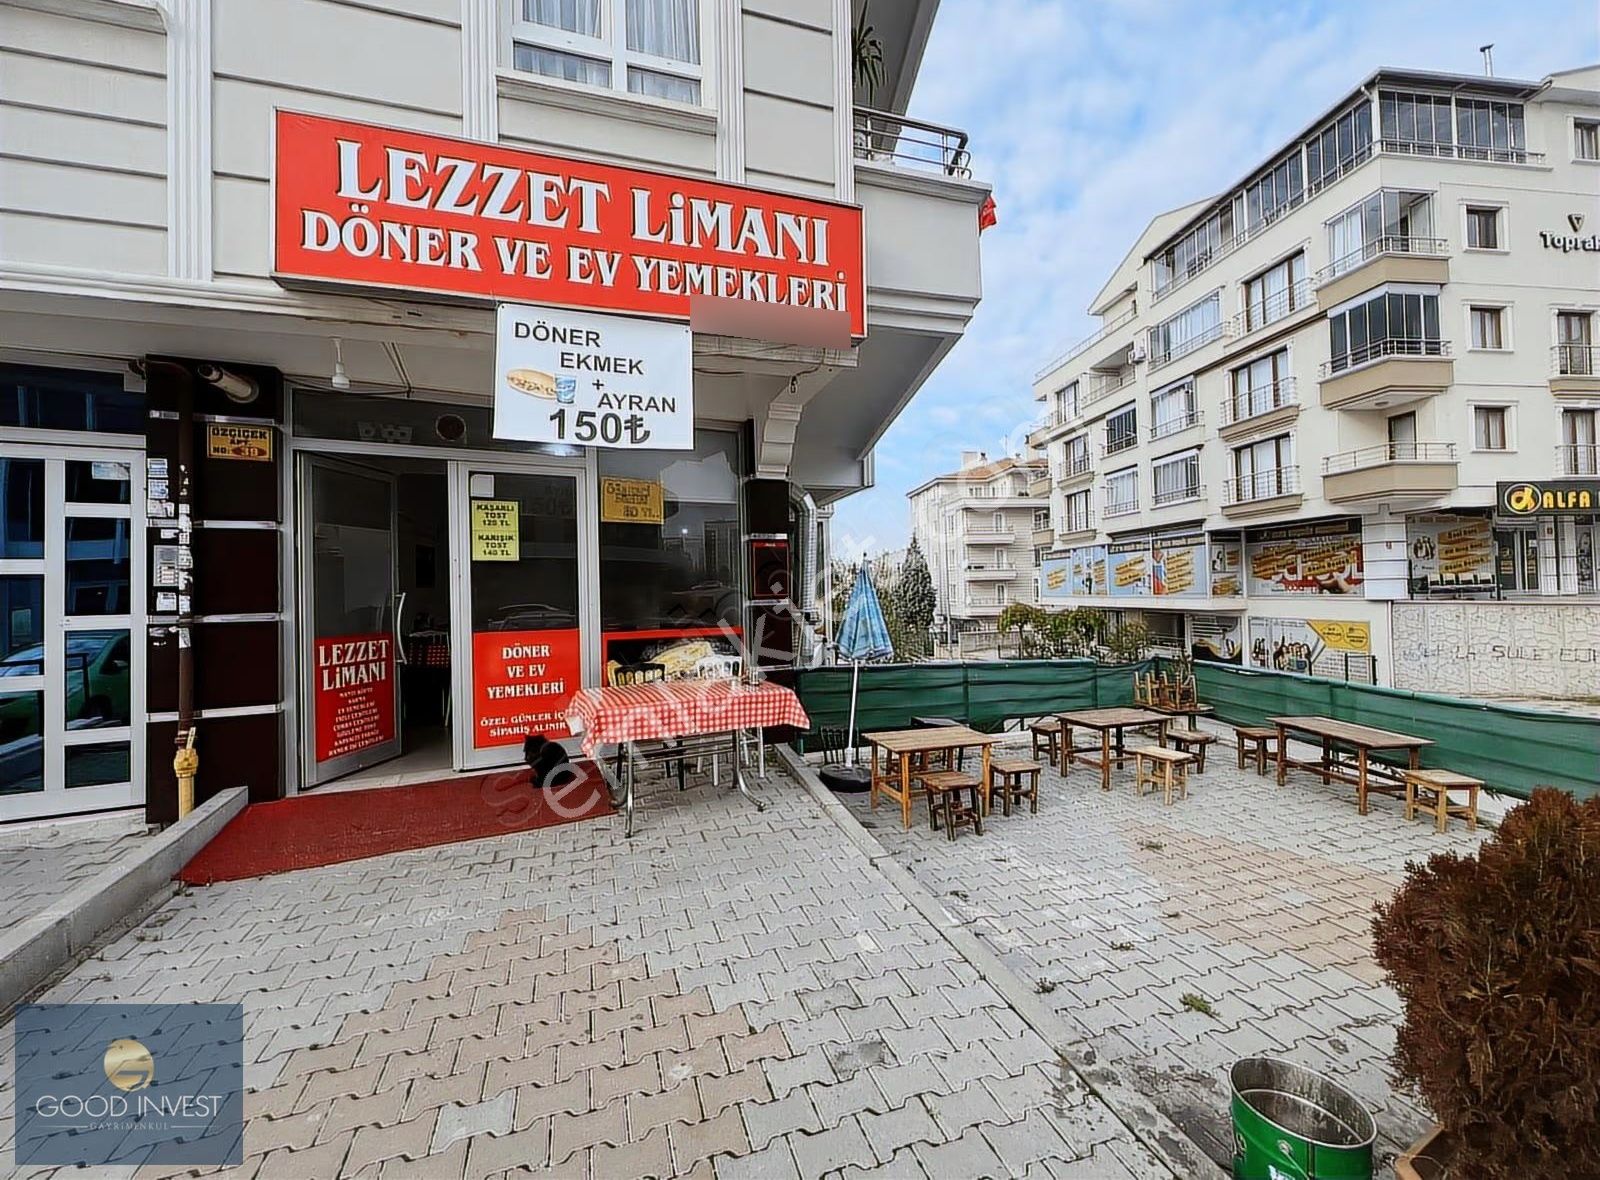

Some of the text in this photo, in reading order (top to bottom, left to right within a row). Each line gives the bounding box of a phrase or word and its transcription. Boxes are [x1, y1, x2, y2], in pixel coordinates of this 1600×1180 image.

[336, 138, 610, 234] LEZZET
[301, 203, 482, 273] DÖNER
[494, 237, 554, 282] VE
[567, 246, 623, 288] EV
[514, 321, 602, 348] DÖNER
[560, 351, 645, 376] EKMEK
[597, 393, 678, 414] AYRAN
[1542, 490, 1592, 509] ALFA
[319, 639, 389, 667] LEZZET
[502, 642, 551, 660] DÖNER
[507, 663, 546, 679] VE EV
[487, 677, 565, 700] YEMEKLERİ
